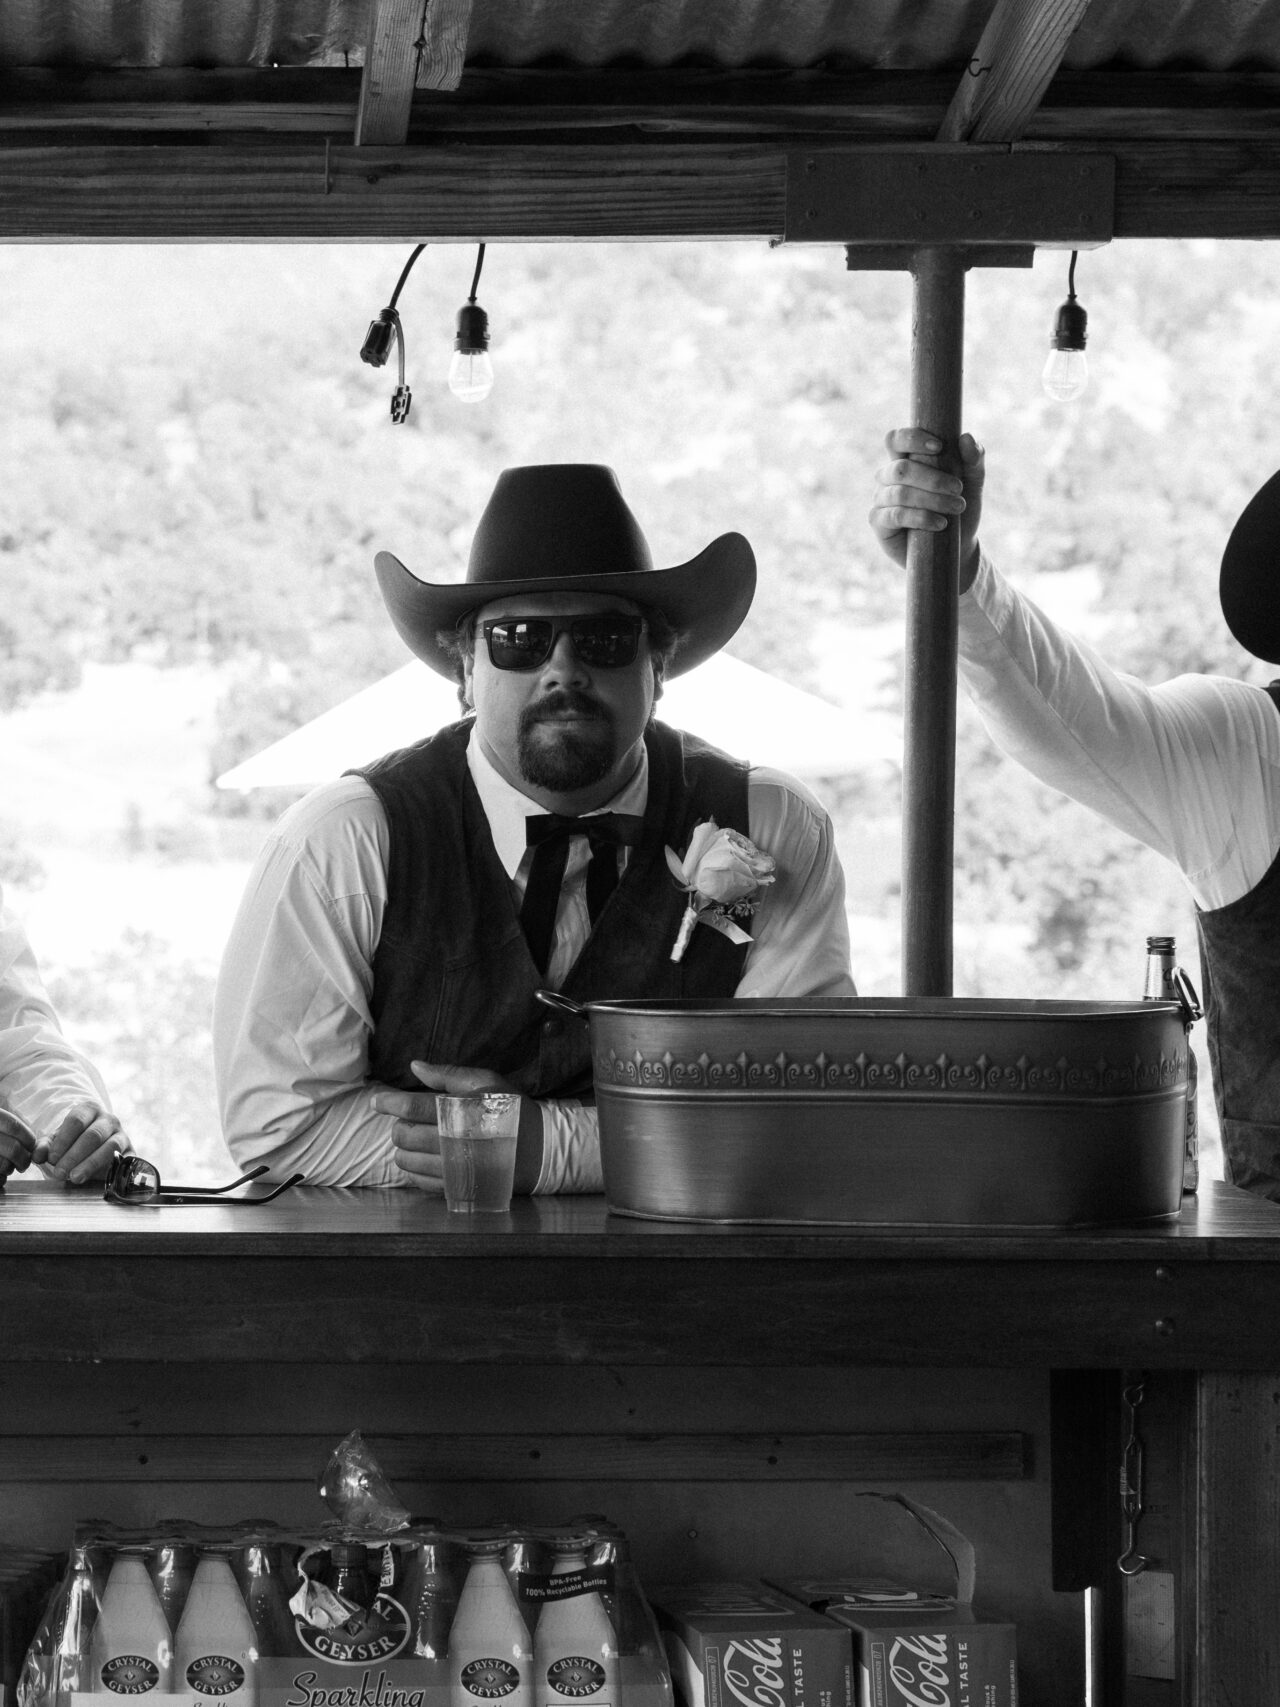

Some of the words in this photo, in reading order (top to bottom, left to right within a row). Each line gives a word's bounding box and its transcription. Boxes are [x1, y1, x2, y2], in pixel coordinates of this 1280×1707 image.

[525, 1587, 546, 1597] 100%
[546, 1583, 582, 1596] Recyclable
[583, 1577, 607, 1587] Bottles
[549, 1575, 581, 1586] BPA-Free
[315, 1636, 396, 1659] GEYSER
[108, 1656, 152, 1672] CRYSTAL
[193, 1657, 237, 1672] CRYSTAL
[467, 1659, 512, 1675] CRYSTAL
[553, 1658, 598, 1673] CRYSTAL
[958, 1642, 969, 1690] TASTE
[793, 1648, 804, 1696] TASTE
[109, 1680, 153, 1693] GEYSER
[194, 1680, 238, 1694] GEYSER
[287, 1670, 425, 1707] Sparkling
[469, 1682, 514, 1697] GEYSER
[555, 1680, 600, 1695] GEYSER
